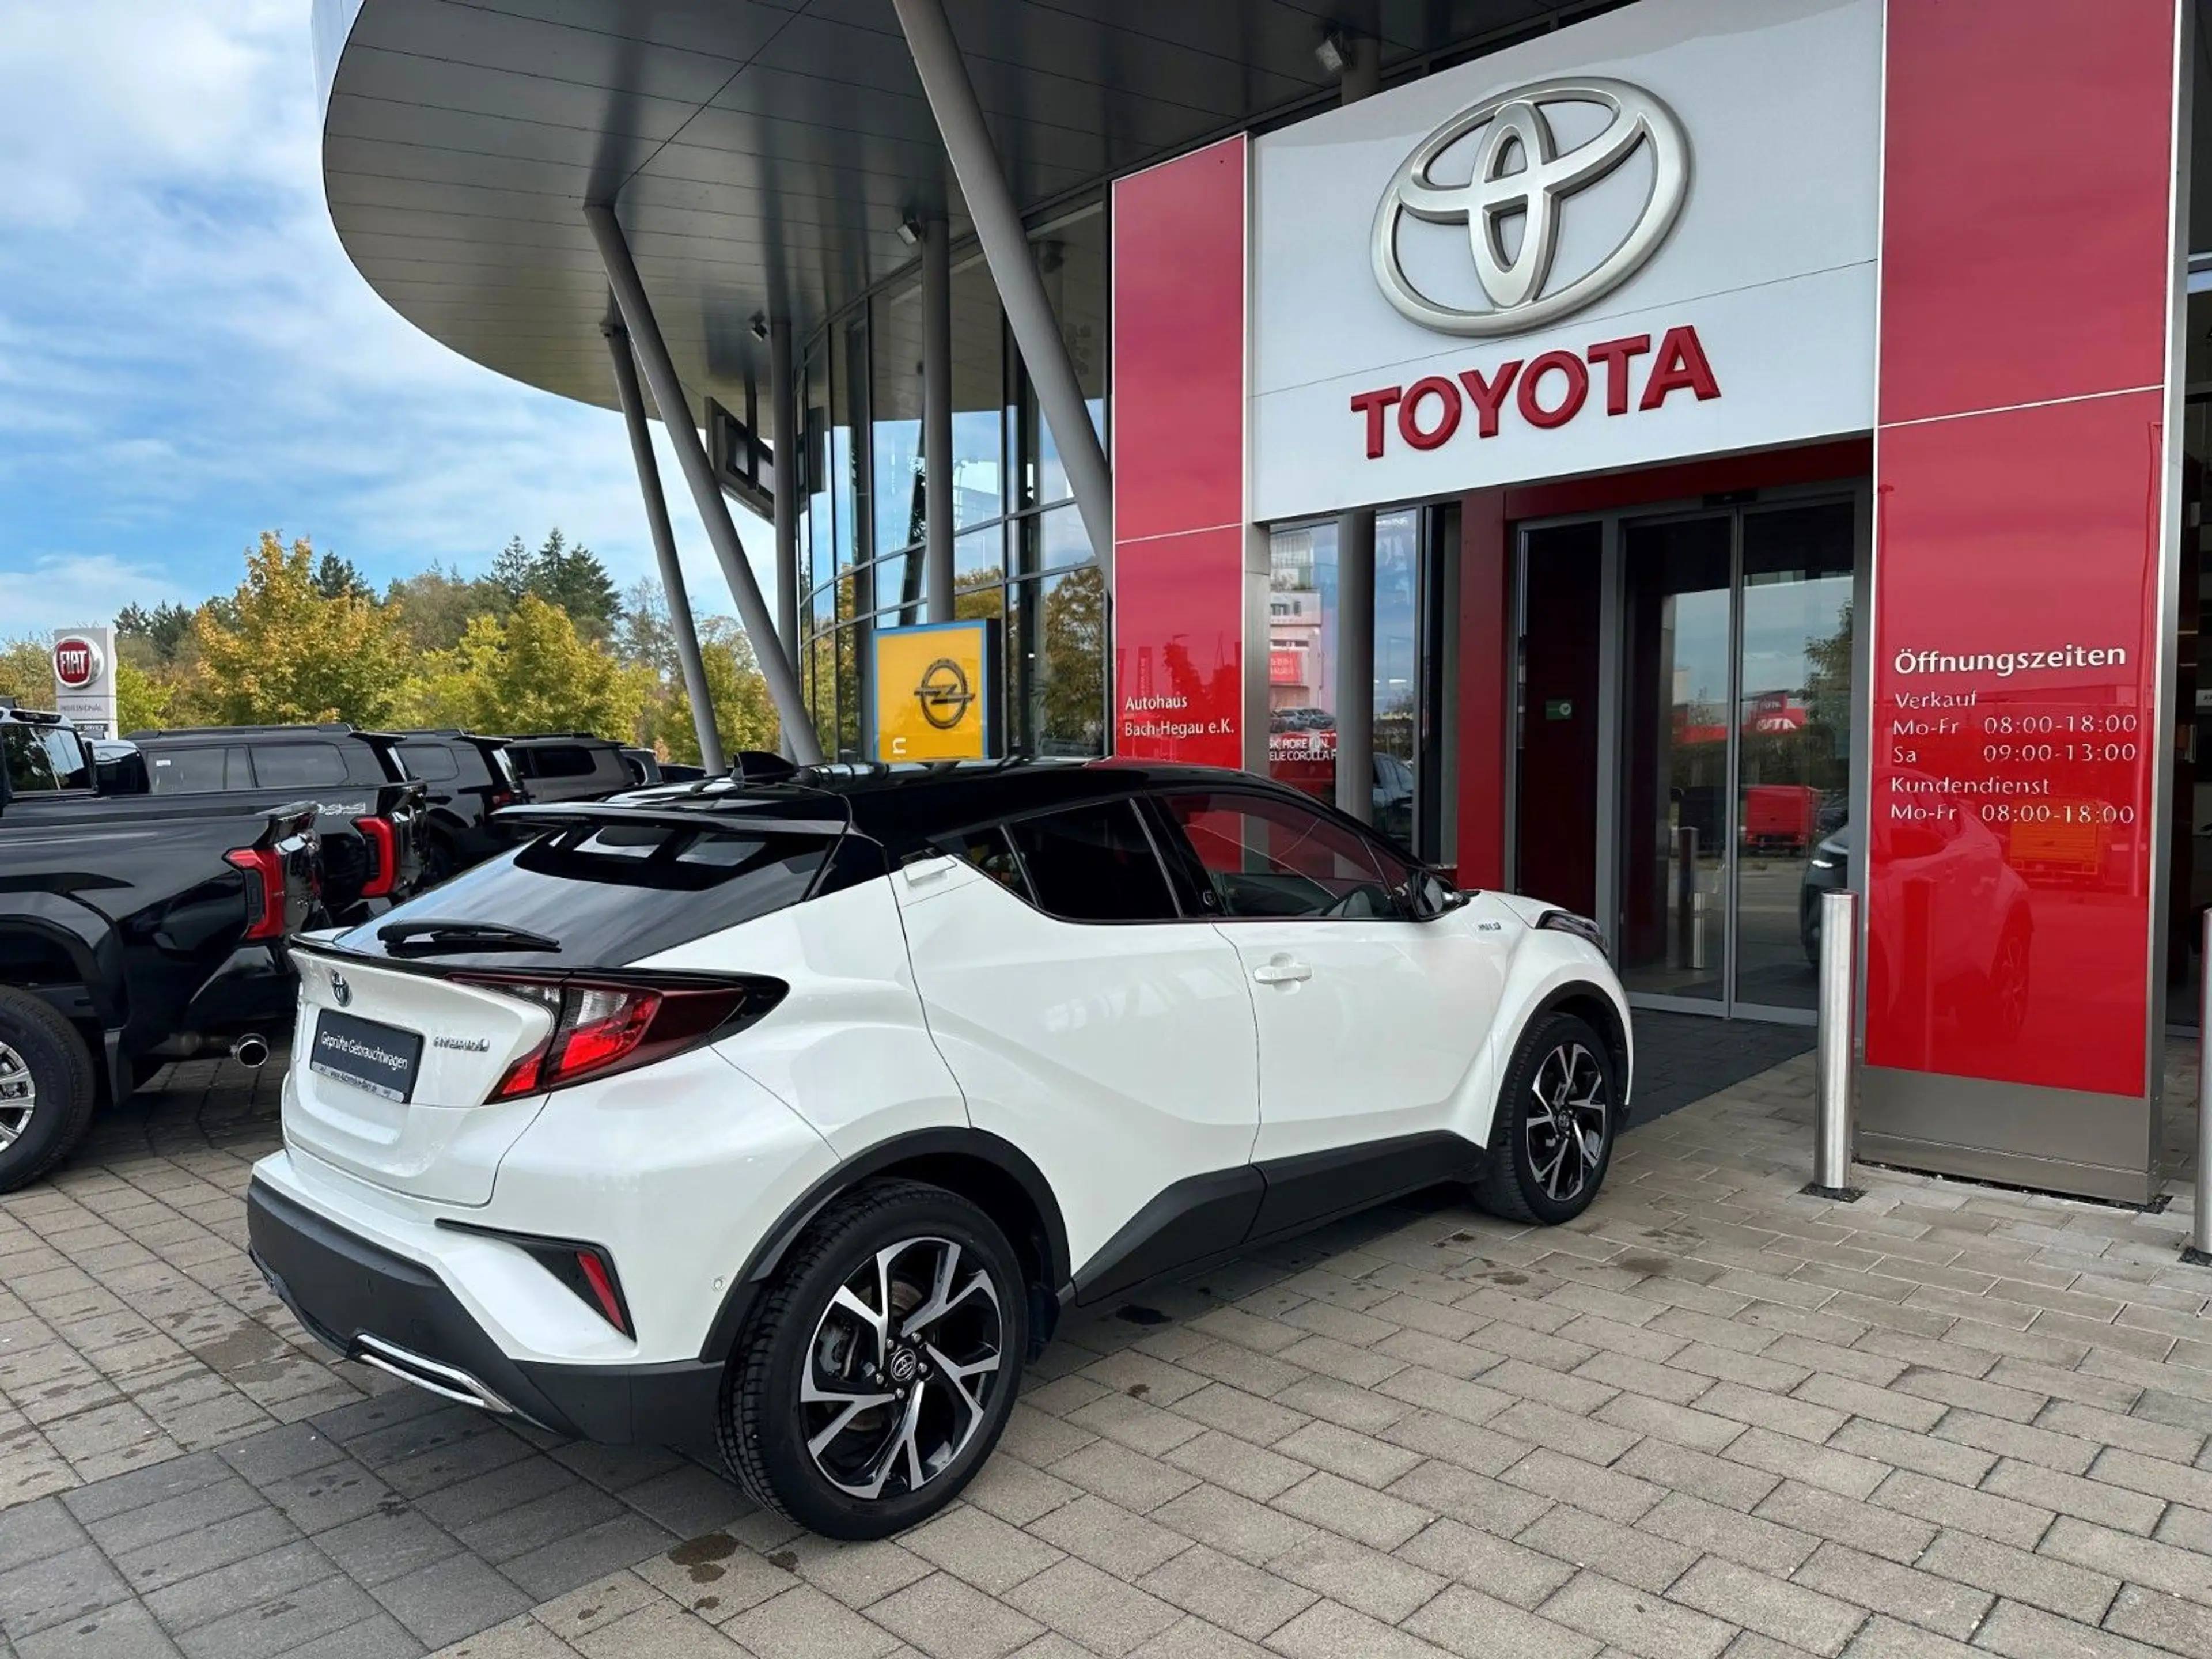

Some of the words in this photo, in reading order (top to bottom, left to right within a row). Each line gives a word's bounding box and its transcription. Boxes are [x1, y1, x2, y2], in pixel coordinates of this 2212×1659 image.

[1351, 325, 1721, 459] TOYOTA
[59, 650, 86, 675] FIAT
[1895, 645, 2126, 677] Öffnungszeiten
[1125, 694, 1187, 710] Autohaus
[1895, 690, 1977, 709] Verkauf
[1124, 720, 1204, 739] Bach-Hegau
[1208, 718, 1234, 734] e.K.
[1893, 719, 1959, 736] Mo-Fr
[1984, 715, 2137, 734] 08:00-18:00
[1287, 751, 1330, 761] COROLLA
[1893, 746, 1916, 763] Sa
[1983, 744, 2136, 762] 09:00-13:00
[1891, 776, 2049, 794] Kundendienst
[1891, 804, 1957, 821] Mo-Fr
[1982, 805, 2134, 823] 08:00-18:00
[349, 1039, 408, 1070] Gebrauchtwagen
